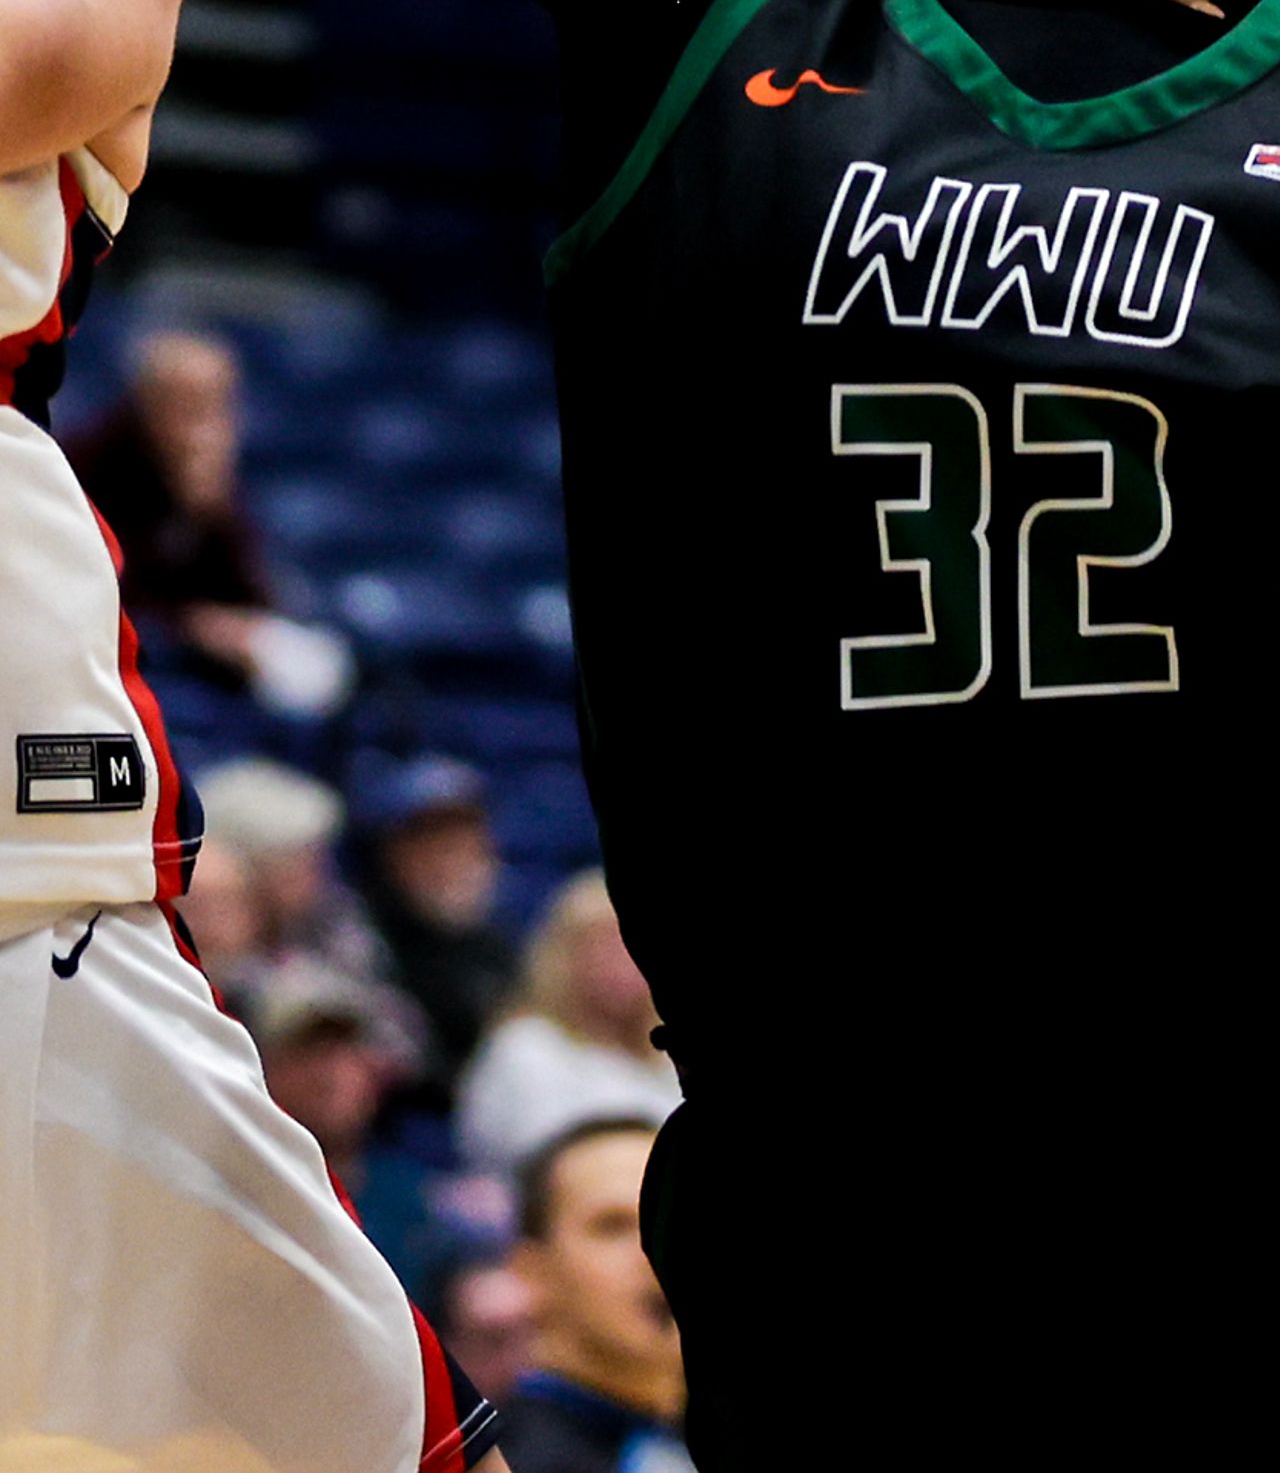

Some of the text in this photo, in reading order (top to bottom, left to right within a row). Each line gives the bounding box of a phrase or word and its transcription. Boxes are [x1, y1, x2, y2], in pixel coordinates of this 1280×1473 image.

[803, 161, 1215, 348] WWU
[830, 383, 1180, 710] 32
[110, 756, 131, 786] M
